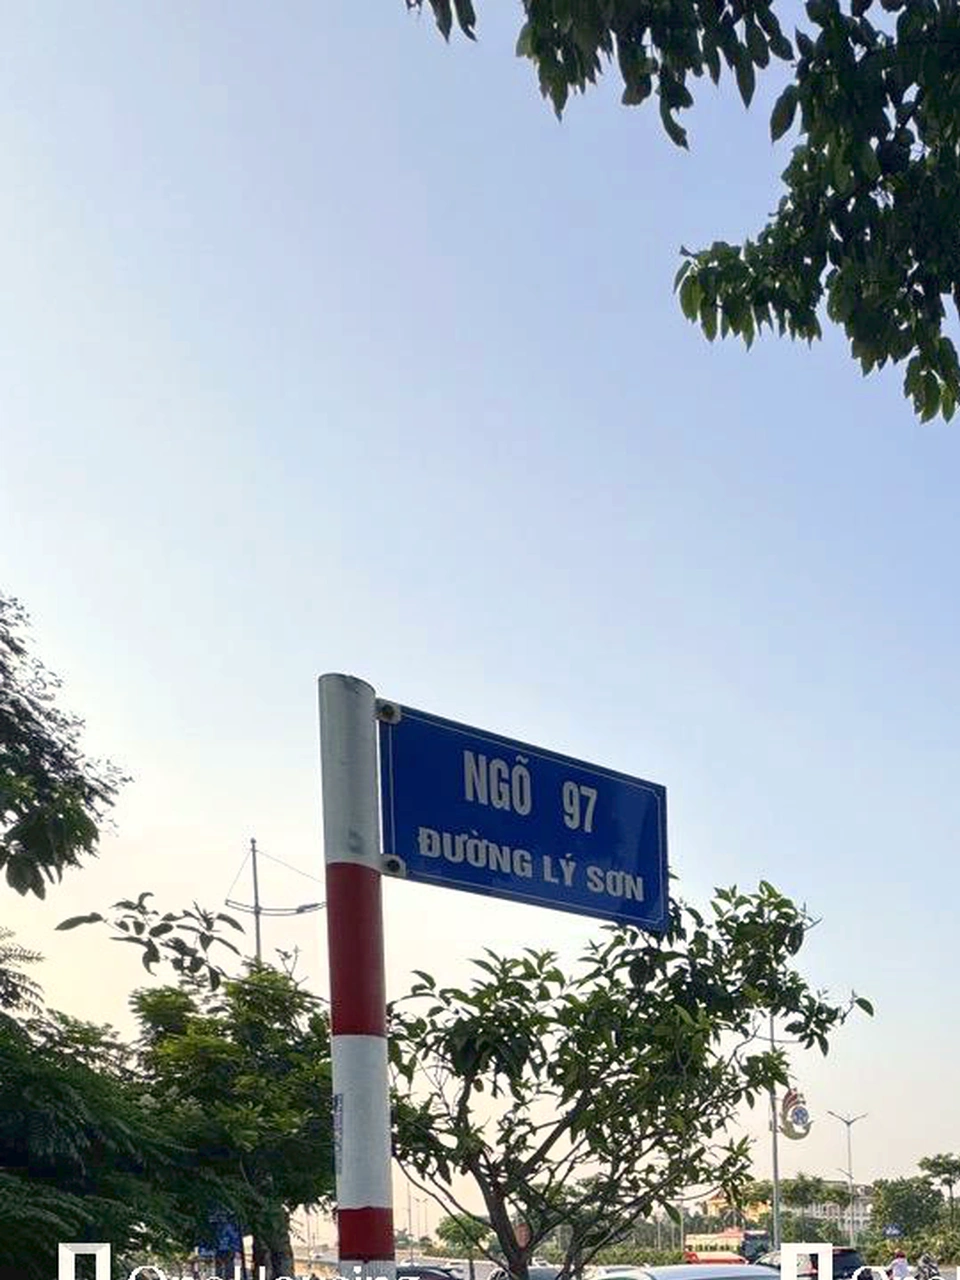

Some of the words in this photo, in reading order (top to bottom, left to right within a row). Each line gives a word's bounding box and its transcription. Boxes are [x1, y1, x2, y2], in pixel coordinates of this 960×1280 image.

[463, 749, 532, 817] NGÕ
[562, 781, 598, 833] 97
[418, 827, 533, 878] ĐƯỜNG
[542, 853, 577, 887] LÝ
[585, 866, 645, 902] SƠN
